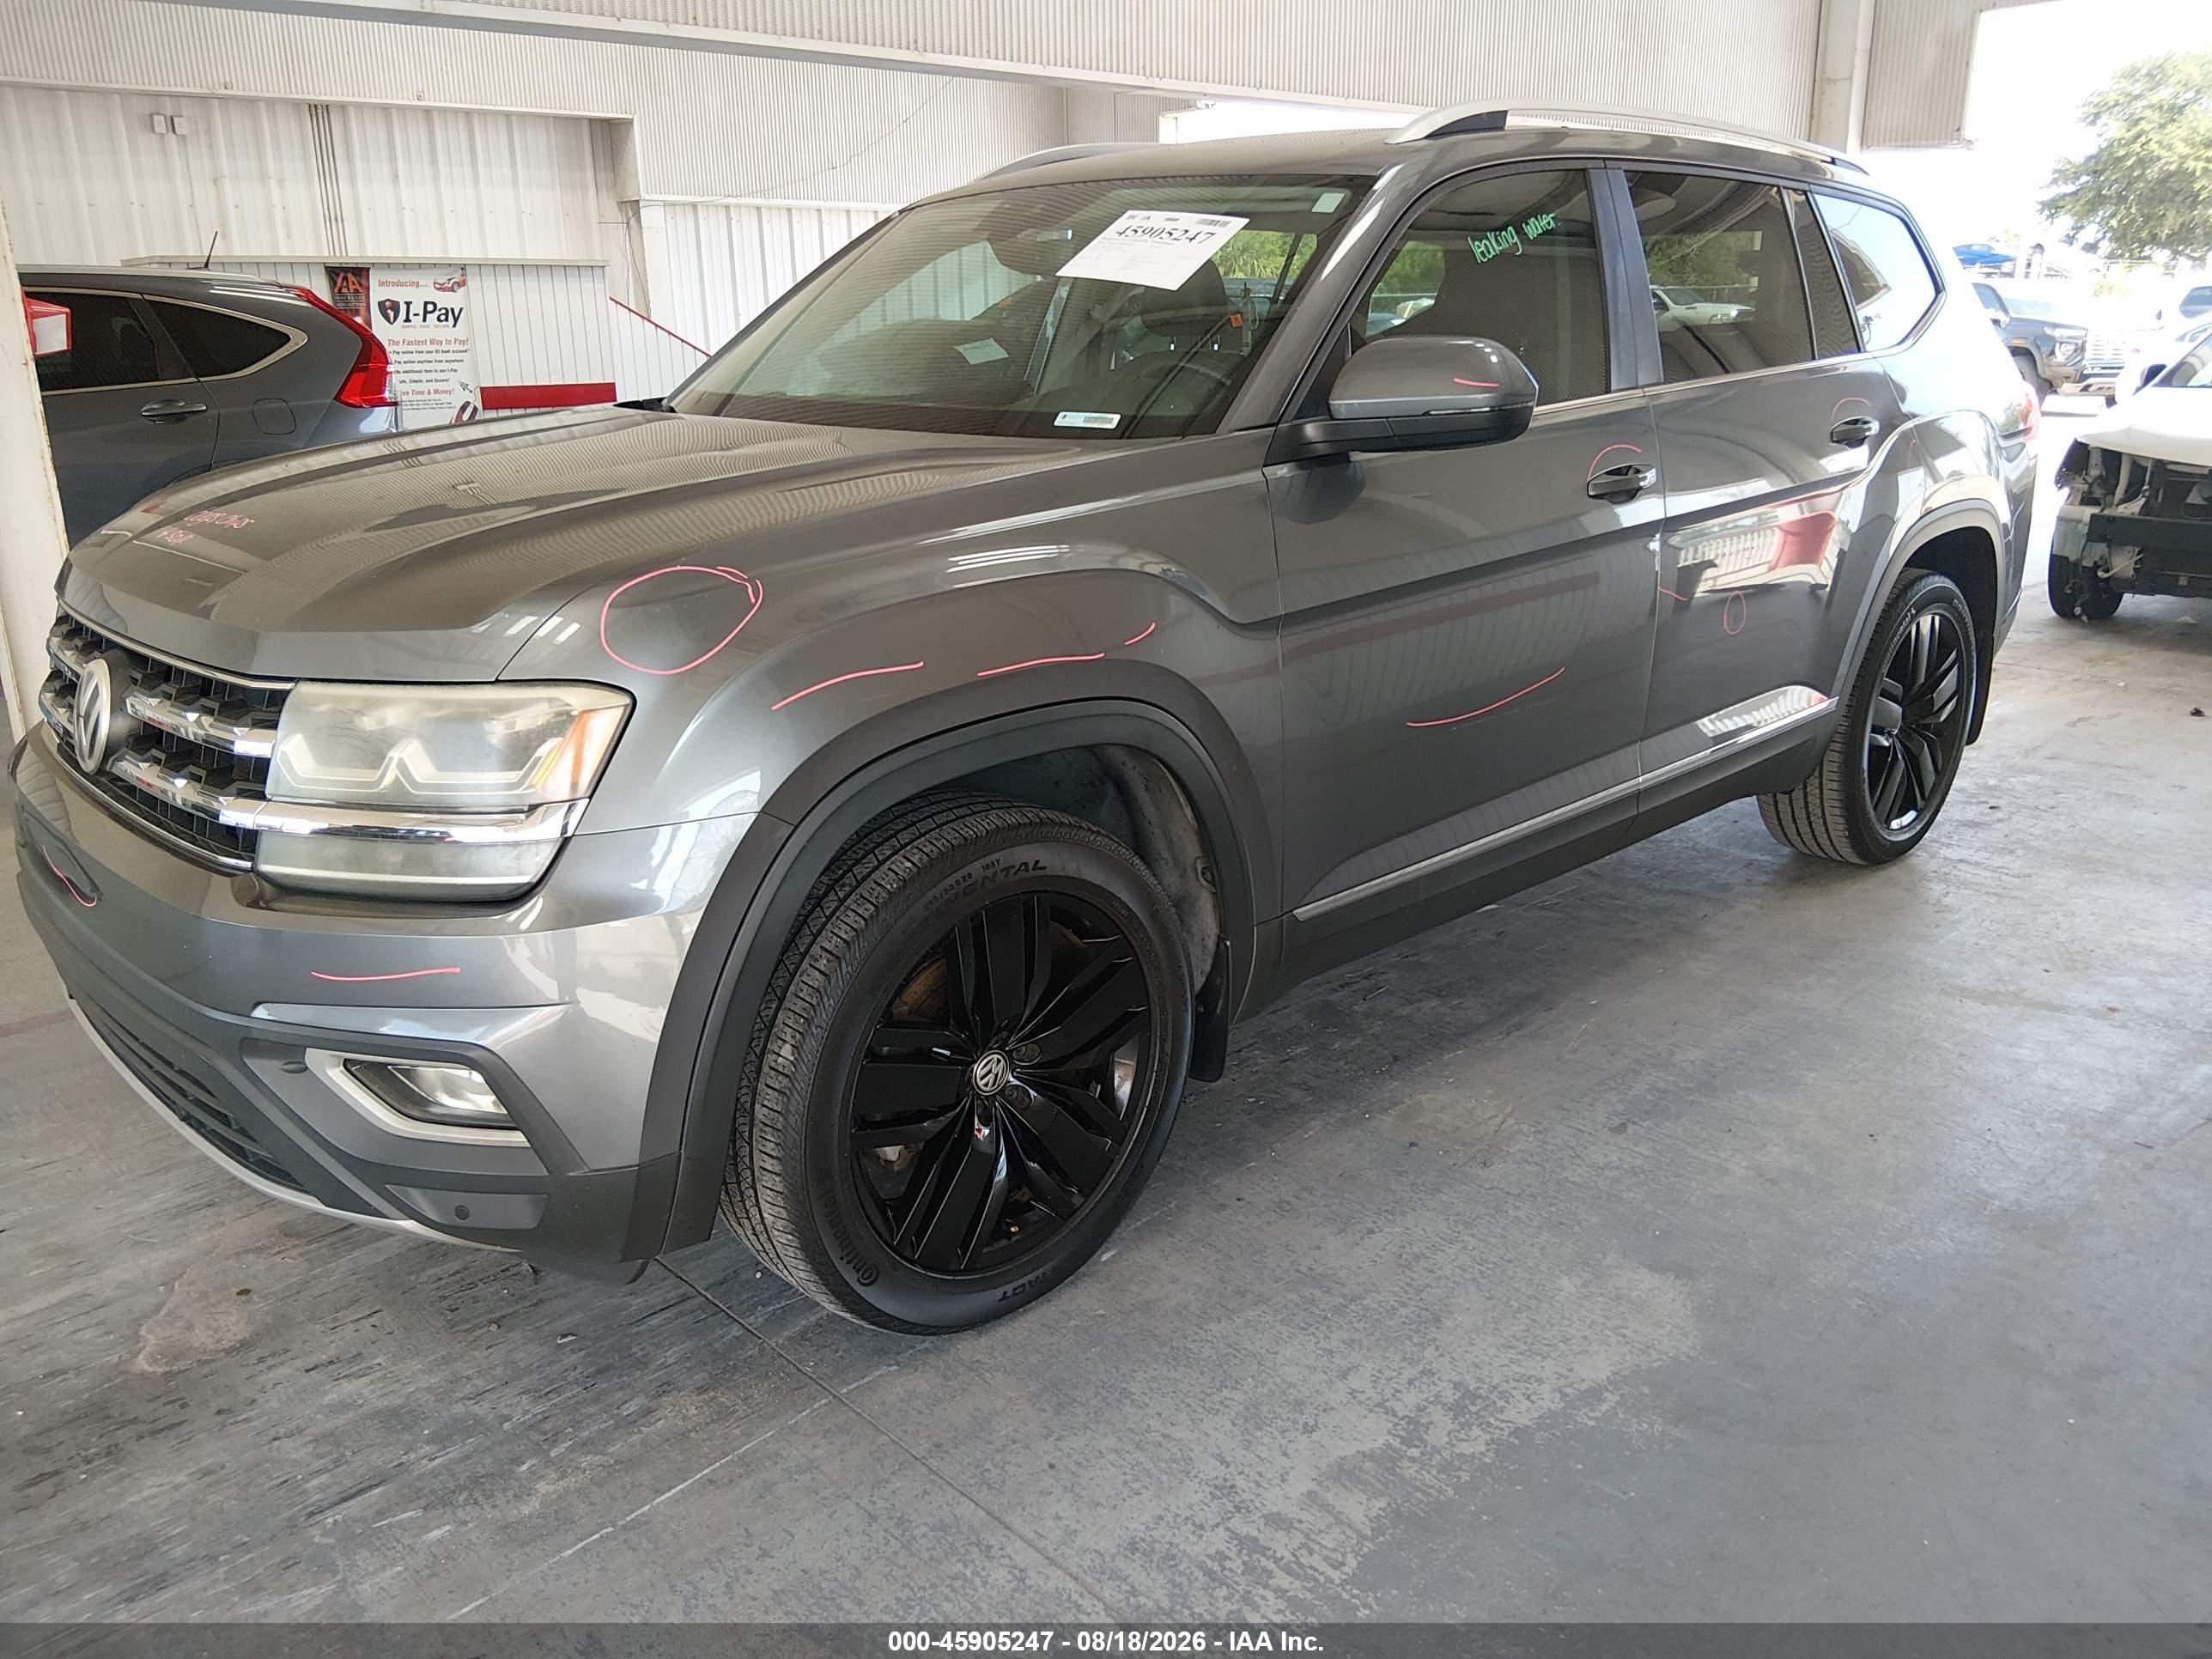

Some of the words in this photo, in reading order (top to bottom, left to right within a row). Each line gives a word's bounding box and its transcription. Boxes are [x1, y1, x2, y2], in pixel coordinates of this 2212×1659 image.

[1115, 225, 1216, 245] 45905247
[1467, 226, 1522, 264] leaking
[378, 278, 428, 289] Introducing...
[403, 301, 464, 329] I-Pay
[388, 338, 401, 347] The
[402, 337, 428, 346] Fastest
[429, 337, 443, 347] Way
[454, 337, 469, 346] Pay!
[433, 387, 454, 396] Money!
